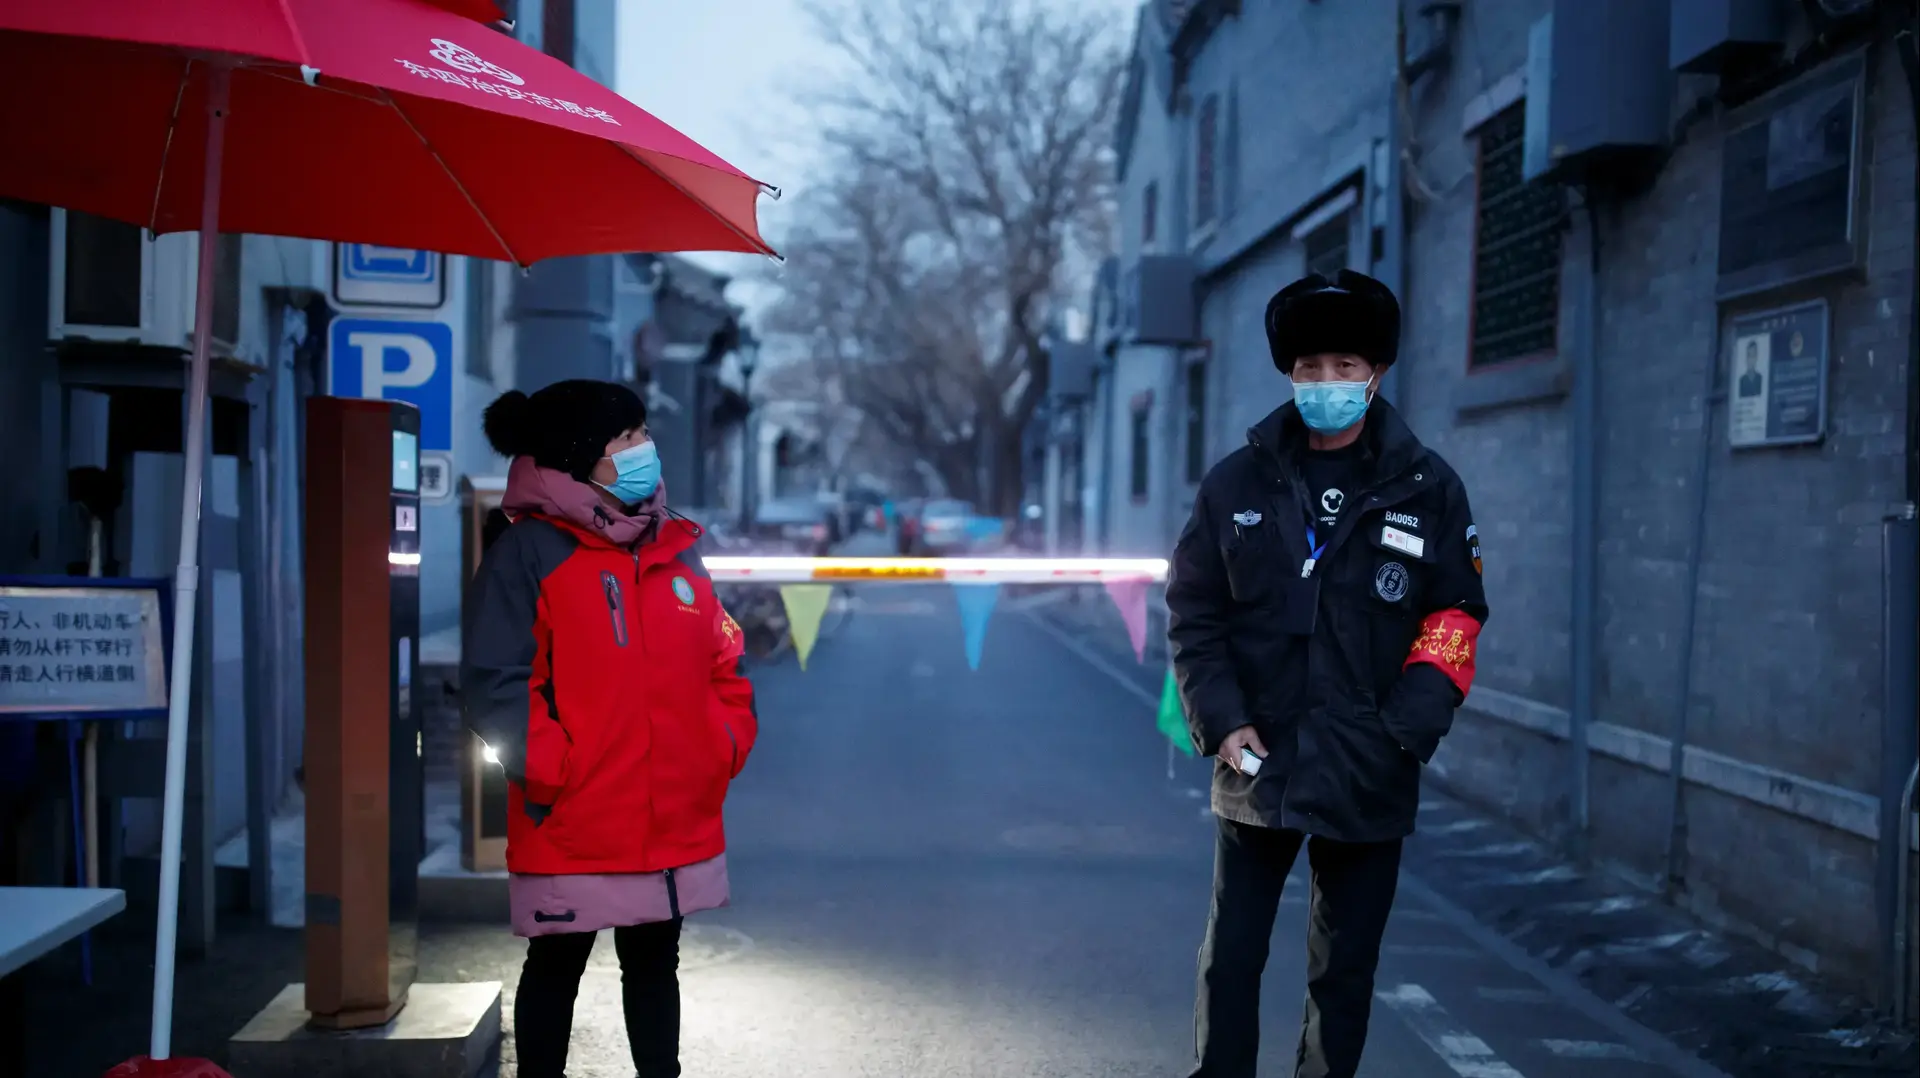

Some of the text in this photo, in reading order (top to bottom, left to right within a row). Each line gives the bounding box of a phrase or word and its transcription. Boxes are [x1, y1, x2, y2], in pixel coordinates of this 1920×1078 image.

[393, 57, 622, 127] 东四治安志愿者
[348, 332, 436, 400] P
[1385, 510, 1418, 528] BA0052
